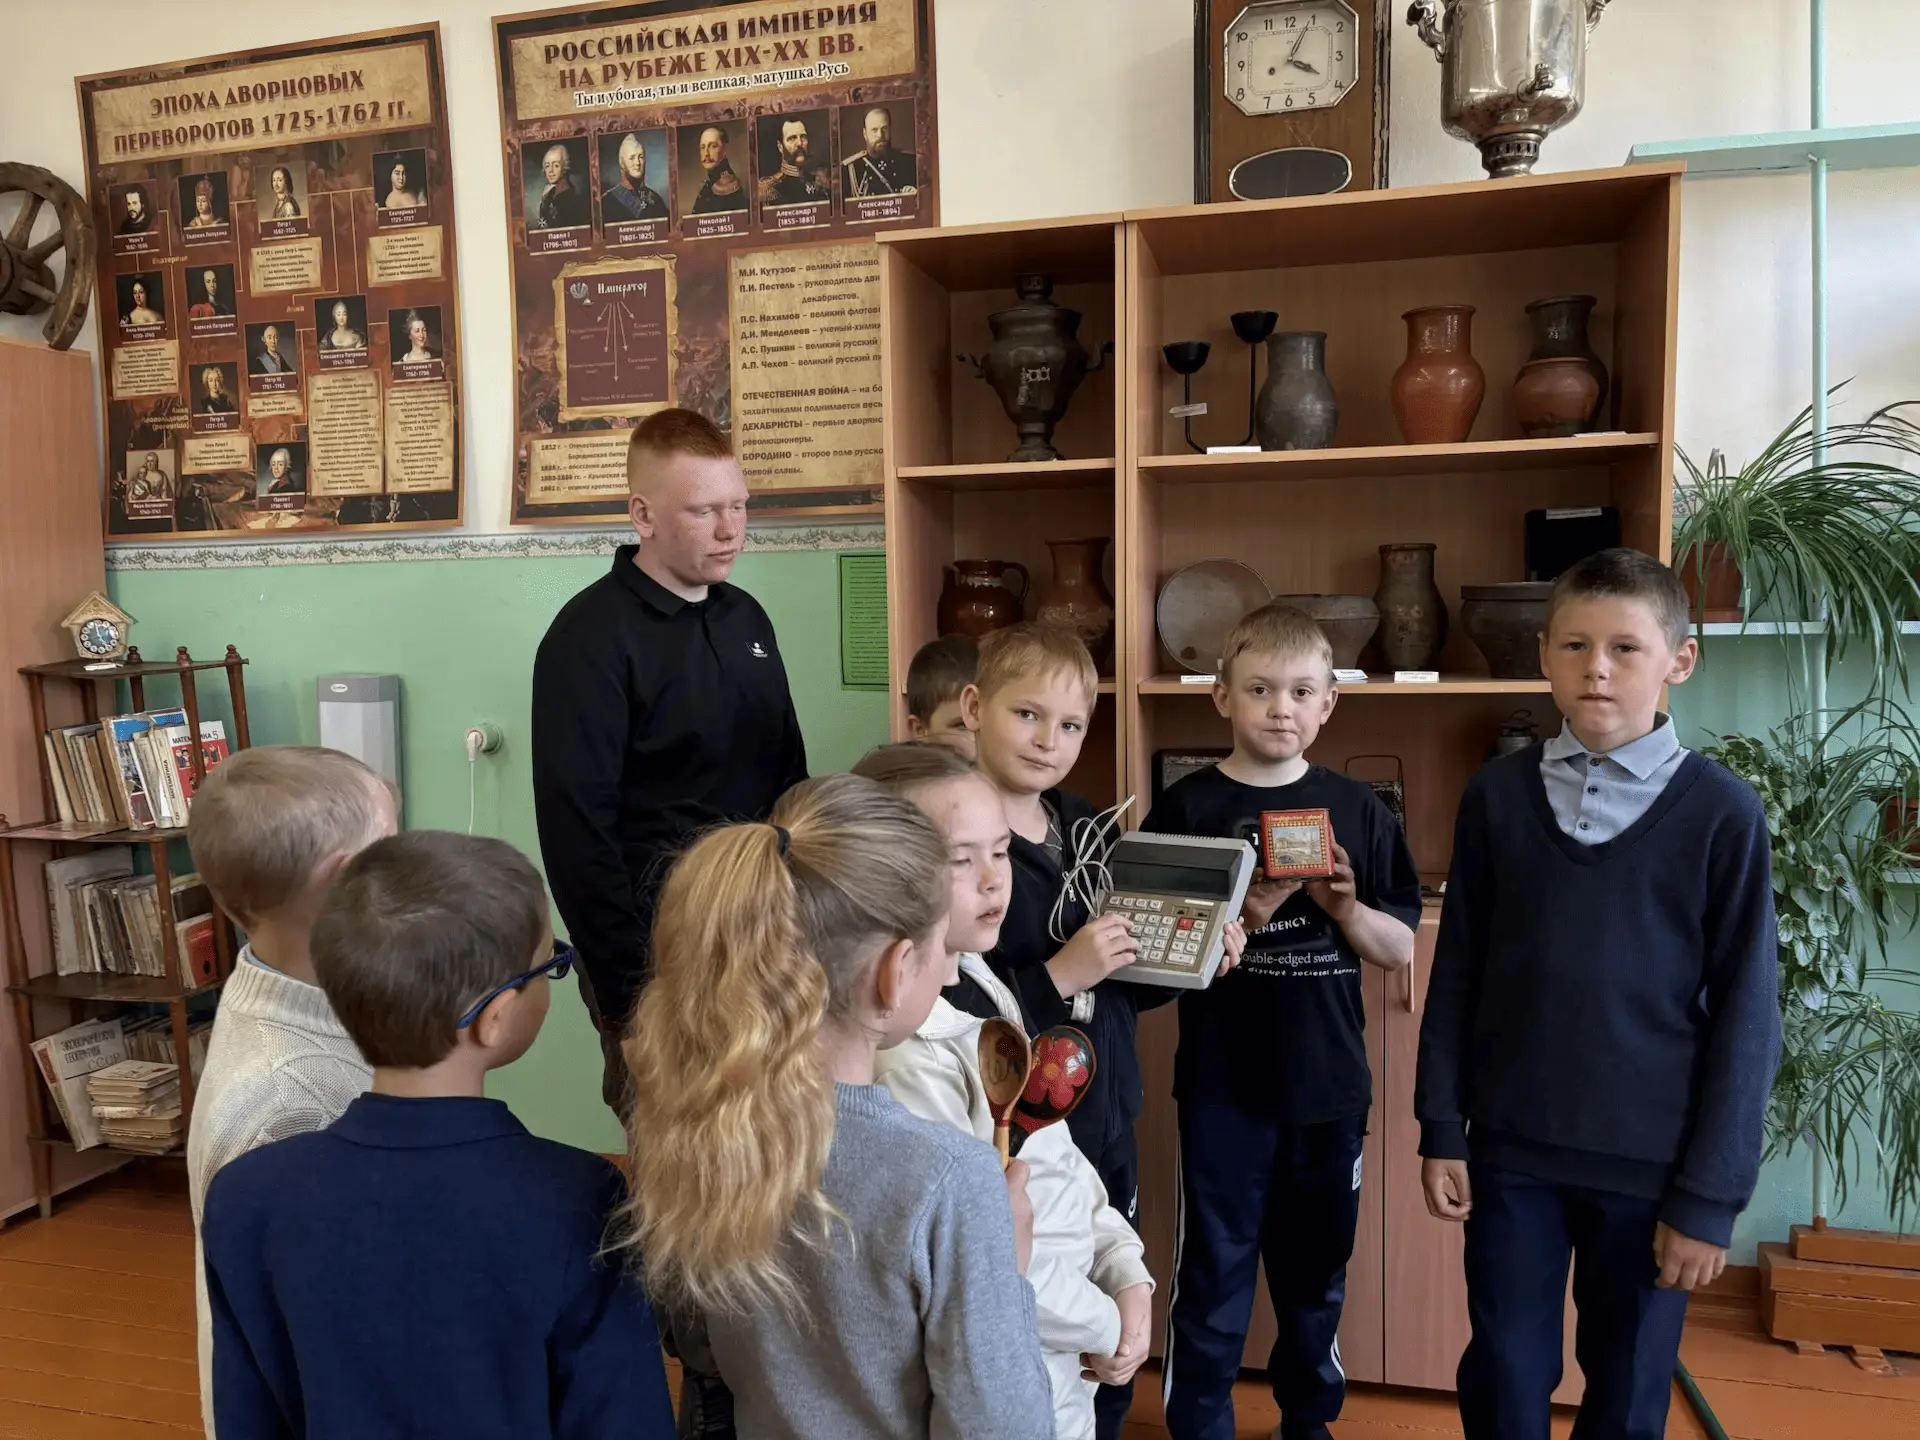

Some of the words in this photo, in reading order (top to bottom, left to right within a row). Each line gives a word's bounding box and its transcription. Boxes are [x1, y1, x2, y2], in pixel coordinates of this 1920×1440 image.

[1264, 19, 1273, 31] 11
[1284, 16, 1296, 28] 12
[1311, 13, 1316, 25] 1
[544, 21, 728, 65] РОССИЙСКАЯ
[737, 1, 877, 40] ИМПЕРИЯ
[1336, 21, 1344, 33] 2
[1236, 32, 1248, 43] 10
[1335, 50, 1343, 61] 3
[559, 67, 595, 89] НА
[602, 51, 707, 84] РУБЕЖЕ
[1237, 60, 1245, 71] 9
[575, 92, 594, 106] Ты
[597, 93, 605, 104] и
[608, 86, 657, 107] убогая,
[658, 84, 676, 96] ты
[680, 82, 688, 93] и
[691, 74, 750, 92] великая,
[753, 68, 814, 87] матушка
[817, 62, 849, 77] Русь
[1334, 80, 1345, 91] 4
[151, 90, 220, 118] ЭПОХА
[224, 69, 364, 106] ДВОРЦОВЫХ
[1236, 88, 1245, 101] 8
[1307, 92, 1315, 105] 5
[1264, 96, 1271, 109] 7
[1285, 94, 1293, 107] 6
[114, 117, 255, 154] ПЕРЕВОРОТОВ
[261, 101, 381, 134] 1725-1762
[858, 198, 894, 209] Александр
[776, 207, 810, 217] Александр
[699, 217, 726, 225] Николай
[738, 267, 759, 277] М.И.
[760, 265, 796, 277] Кутузов
[805, 260, 842, 271] великий
[843, 258, 880, 269] полково
[739, 283, 757, 293] П.И.
[759, 281, 795, 292] Пестель
[804, 276, 863, 289] руководитель
[801, 292, 860, 304] декабристов.
[759, 313, 800, 323] Нахимов
[810, 308, 846, 319] великий
[847, 306, 881, 316] флотов
[760, 328, 810, 339] Менделеев
[760, 344, 796, 356] Пушкин
[805, 339, 841, 351] великий
[843, 337, 878, 349] русский
[761, 360, 789, 369] Чехов
[798, 356, 834, 367] великий
[835, 353, 871, 365] русский
[742, 388, 816, 401] ОТЕЧЕСТВЕННАЯ
[818, 385, 850, 396] ВОЙНА
[742, 406, 803, 416] захватчиками
[804, 402, 861, 413] поднимается
[742, 420, 803, 432] ДЕКАБРИСТЫ
[812, 419, 846, 429] первые
[742, 436, 814, 448] революционеры.
[742, 451, 792, 462] БОРОДИНО
[801, 450, 831, 460] второе
[833, 449, 853, 457] поле
[742, 465, 772, 477] боевой
[774, 466, 803, 475] славы.
[1247, 916, 1311, 936] ENDENCY.
